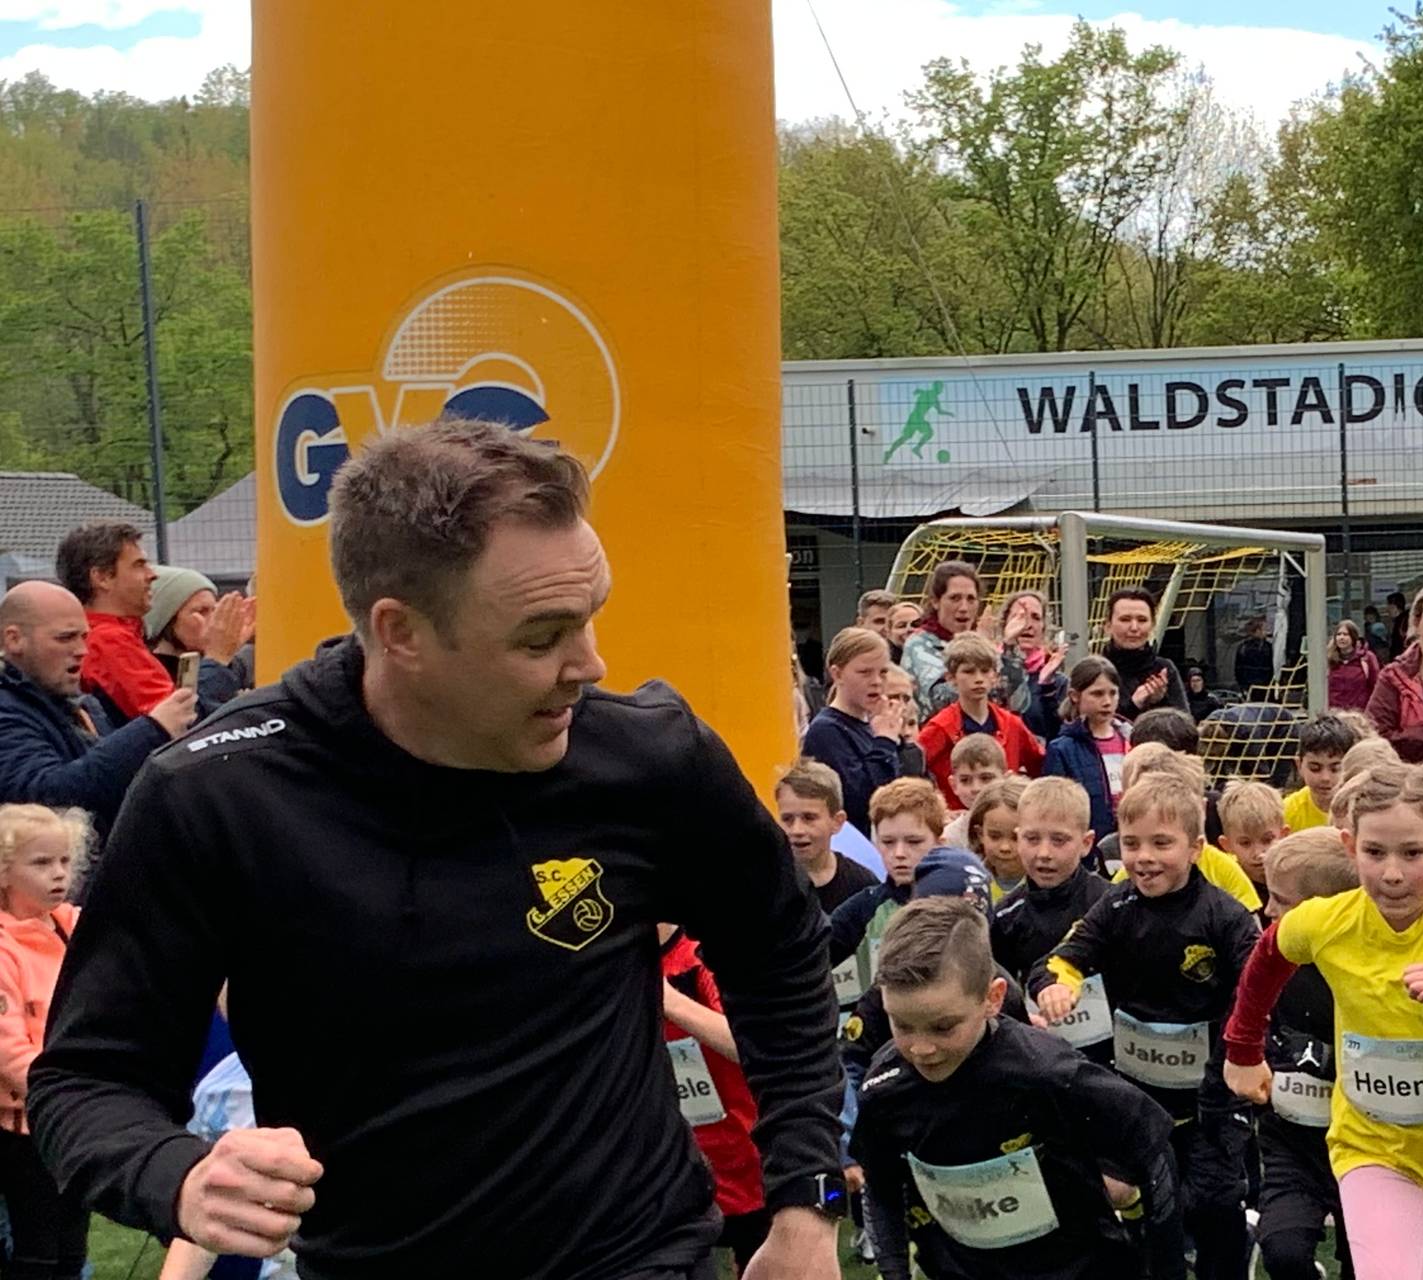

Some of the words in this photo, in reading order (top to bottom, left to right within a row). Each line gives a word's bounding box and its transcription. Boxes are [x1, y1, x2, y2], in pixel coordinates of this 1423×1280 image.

[531, 865, 596, 923] GESSEN
[1123, 1040, 1197, 1068] Jakob
[935, 1192, 1021, 1221] ke
